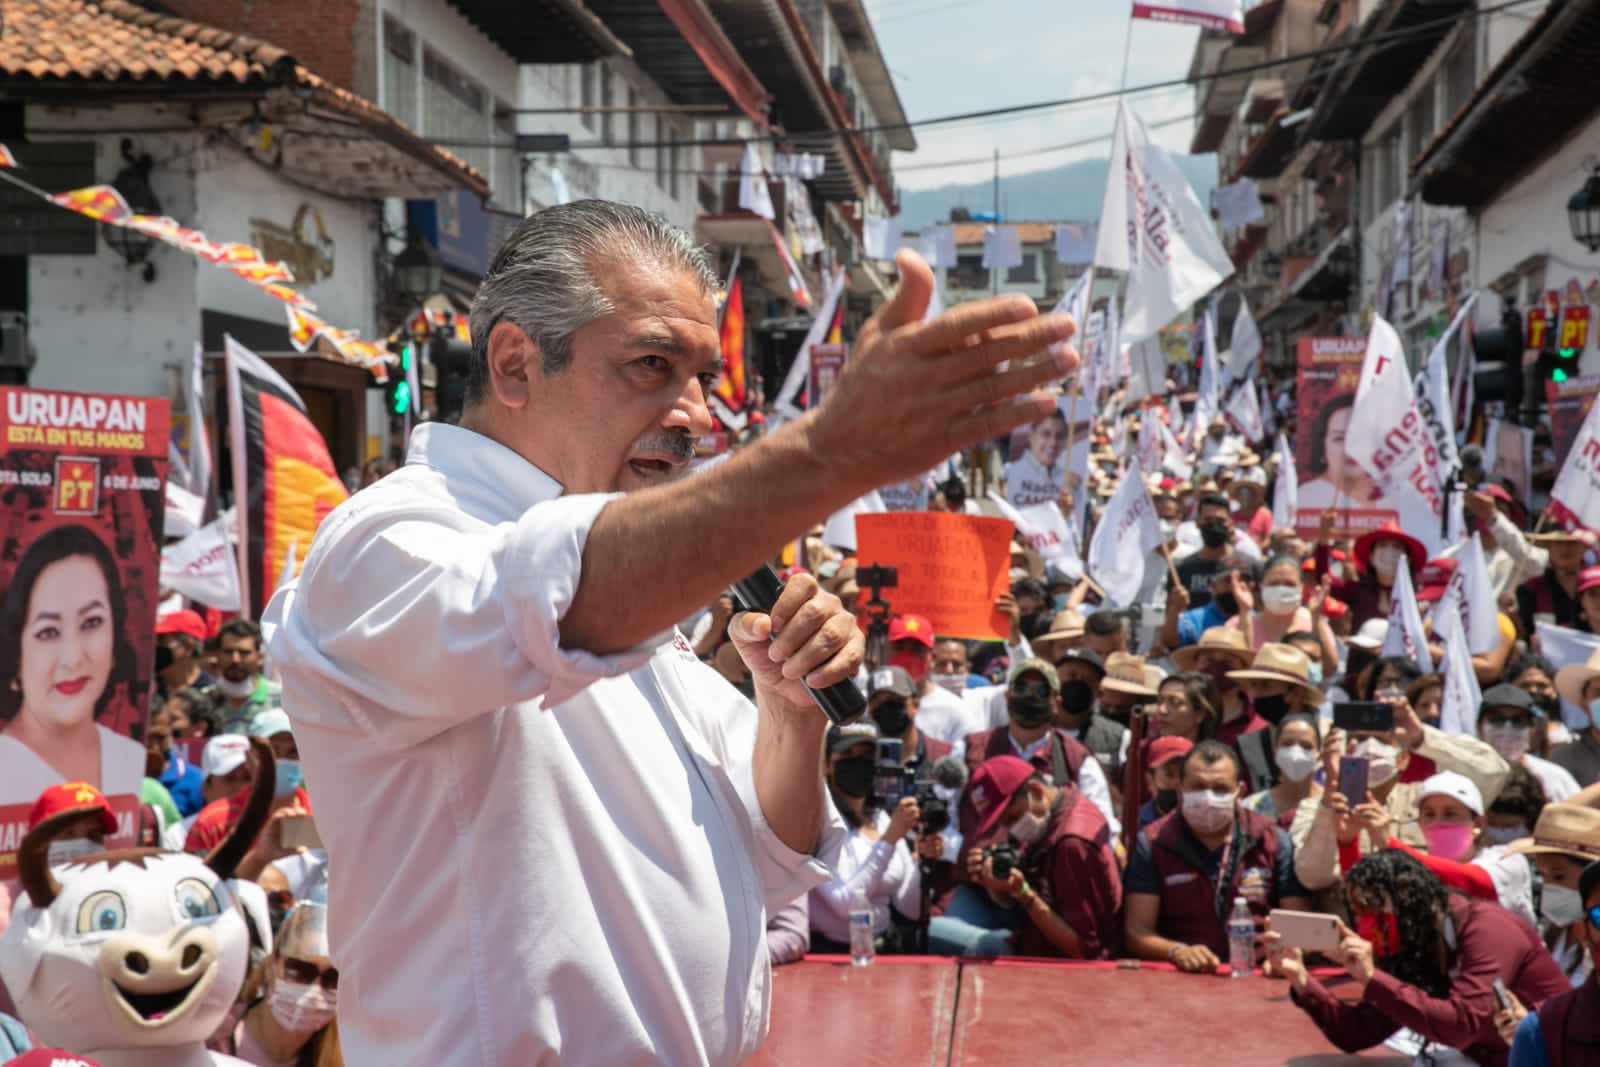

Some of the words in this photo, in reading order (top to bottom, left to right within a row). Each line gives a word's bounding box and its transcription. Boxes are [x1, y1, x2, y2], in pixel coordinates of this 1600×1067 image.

[1531, 320, 1546, 346] T
[1561, 320, 1587, 347] PT
[7, 390, 146, 432] URUAPAN
[7, 424, 45, 444] ESTÁ
[46, 427, 67, 446] EN
[69, 429, 94, 448] TUS
[96, 432, 145, 450] MANOS
[20, 471, 52, 487] SOLO
[112, 475, 129, 490] DE
[130, 476, 161, 491] JUNIO
[59, 479, 94, 509] PT
